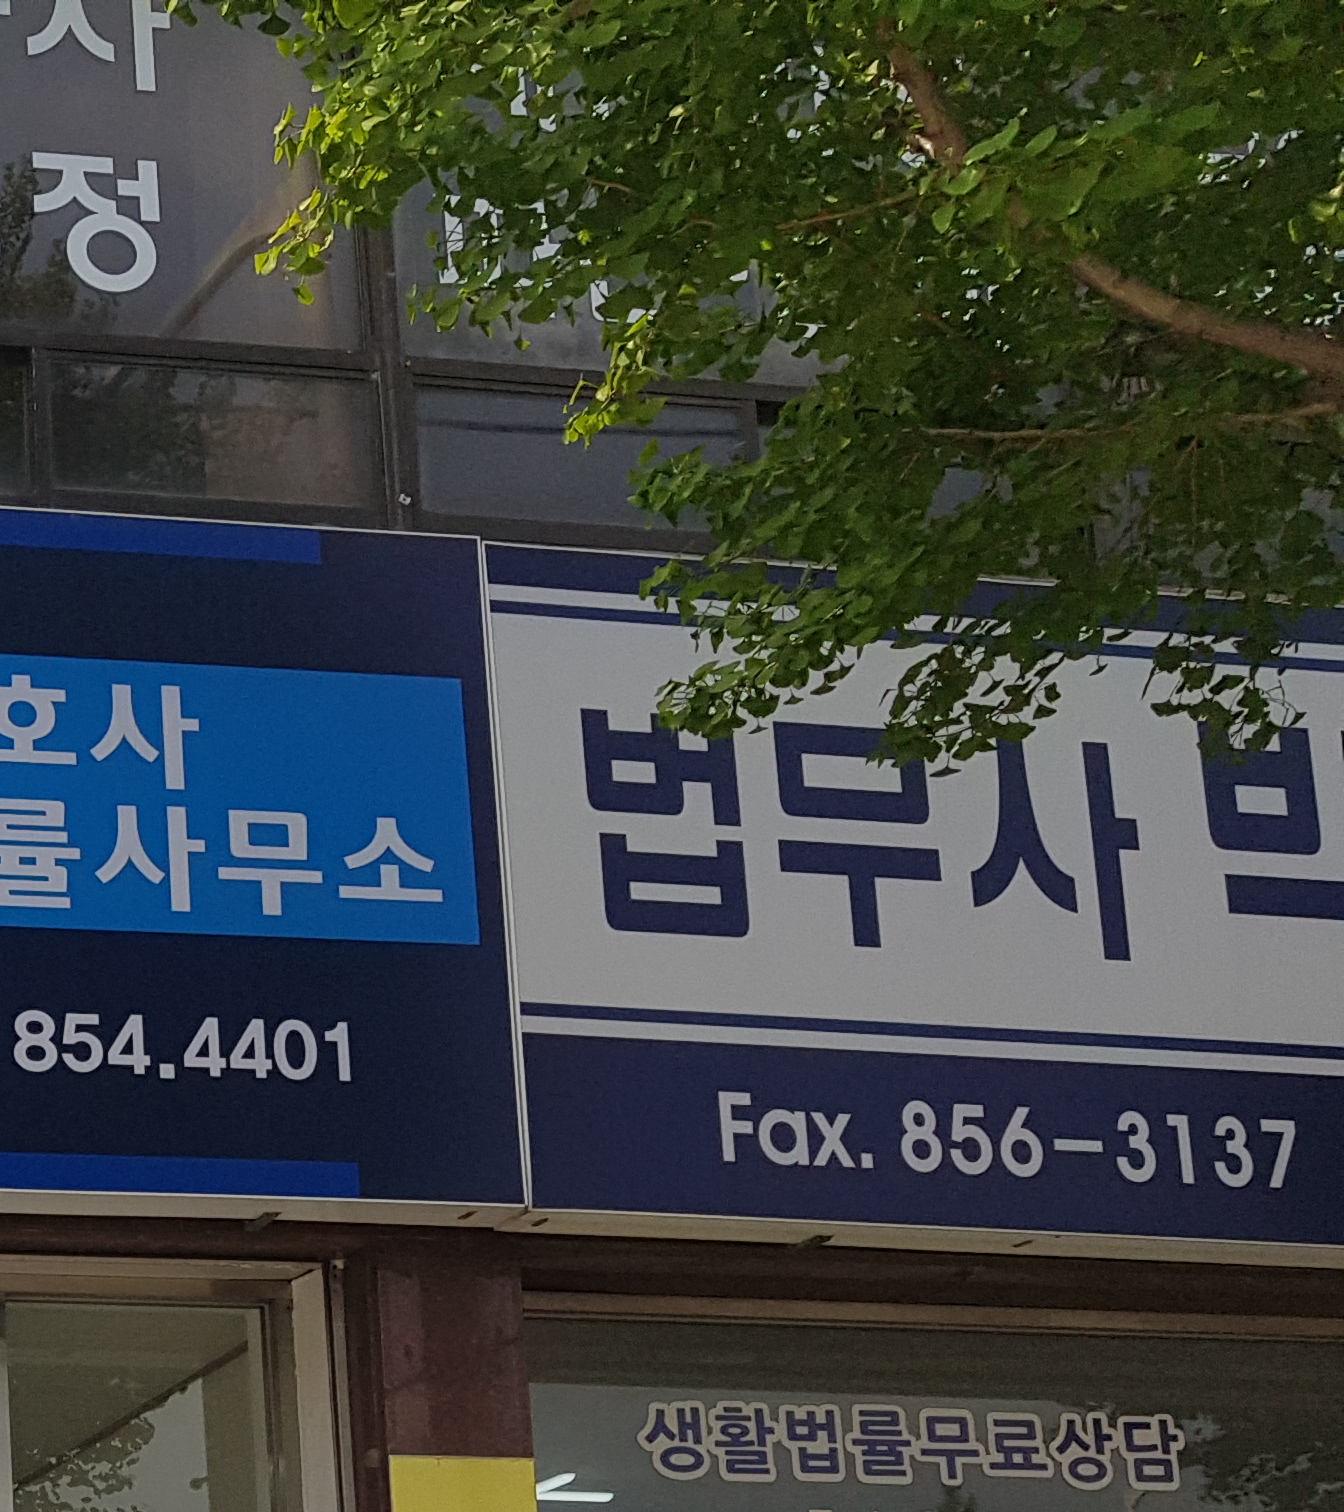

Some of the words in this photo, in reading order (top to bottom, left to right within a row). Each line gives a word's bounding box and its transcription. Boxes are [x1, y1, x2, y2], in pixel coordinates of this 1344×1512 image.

[580, 706, 1141, 962] 법무사
[13, 1009, 352, 1082] 854.4401
[717, 1090, 874, 1169] Fax.
[900, 1100, 1296, 1189] 856-3137
[637, 1400, 1185, 1491] 생활법률무료상담
